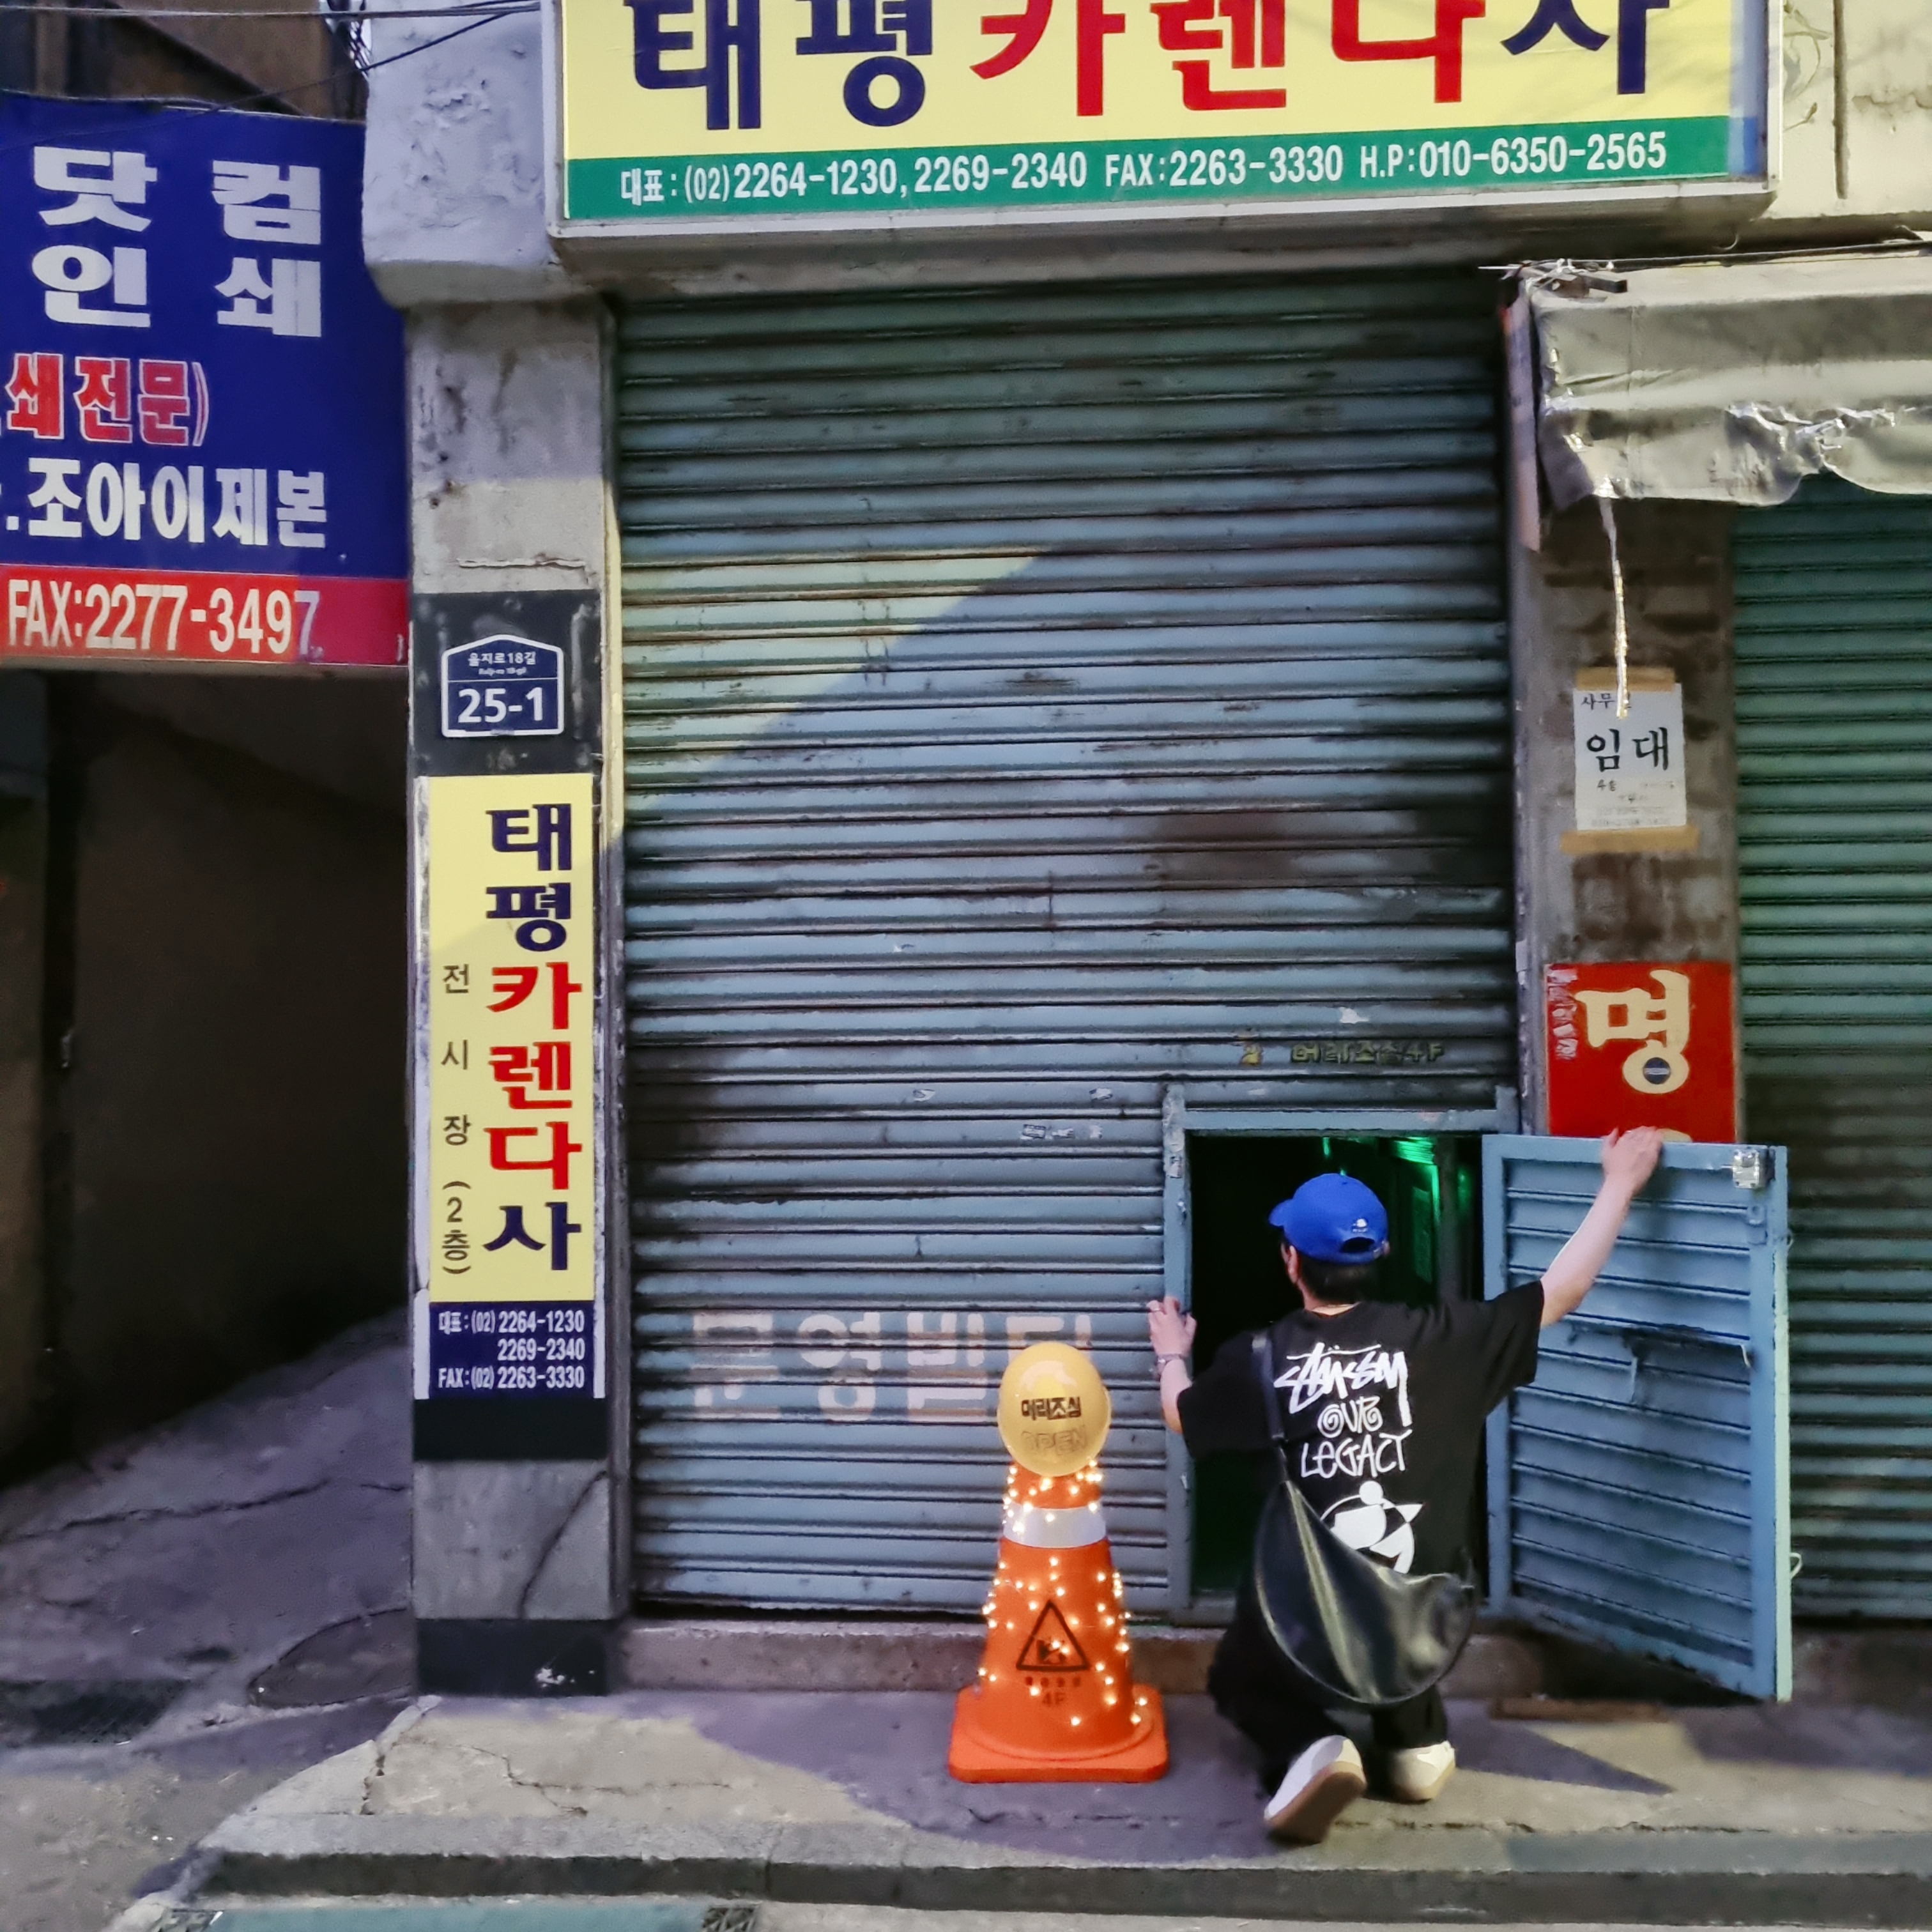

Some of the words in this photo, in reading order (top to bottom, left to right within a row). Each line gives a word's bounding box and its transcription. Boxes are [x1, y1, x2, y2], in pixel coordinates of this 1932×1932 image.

[1105, 144, 1344, 188] FAX:2263-3330
[8, 579, 320, 655] FAX:2277-3497
[457, 687, 543, 723] 25-1
[1580, 693, 1631, 711] 사무
[498, 1338, 585, 1361] 2269-2340
